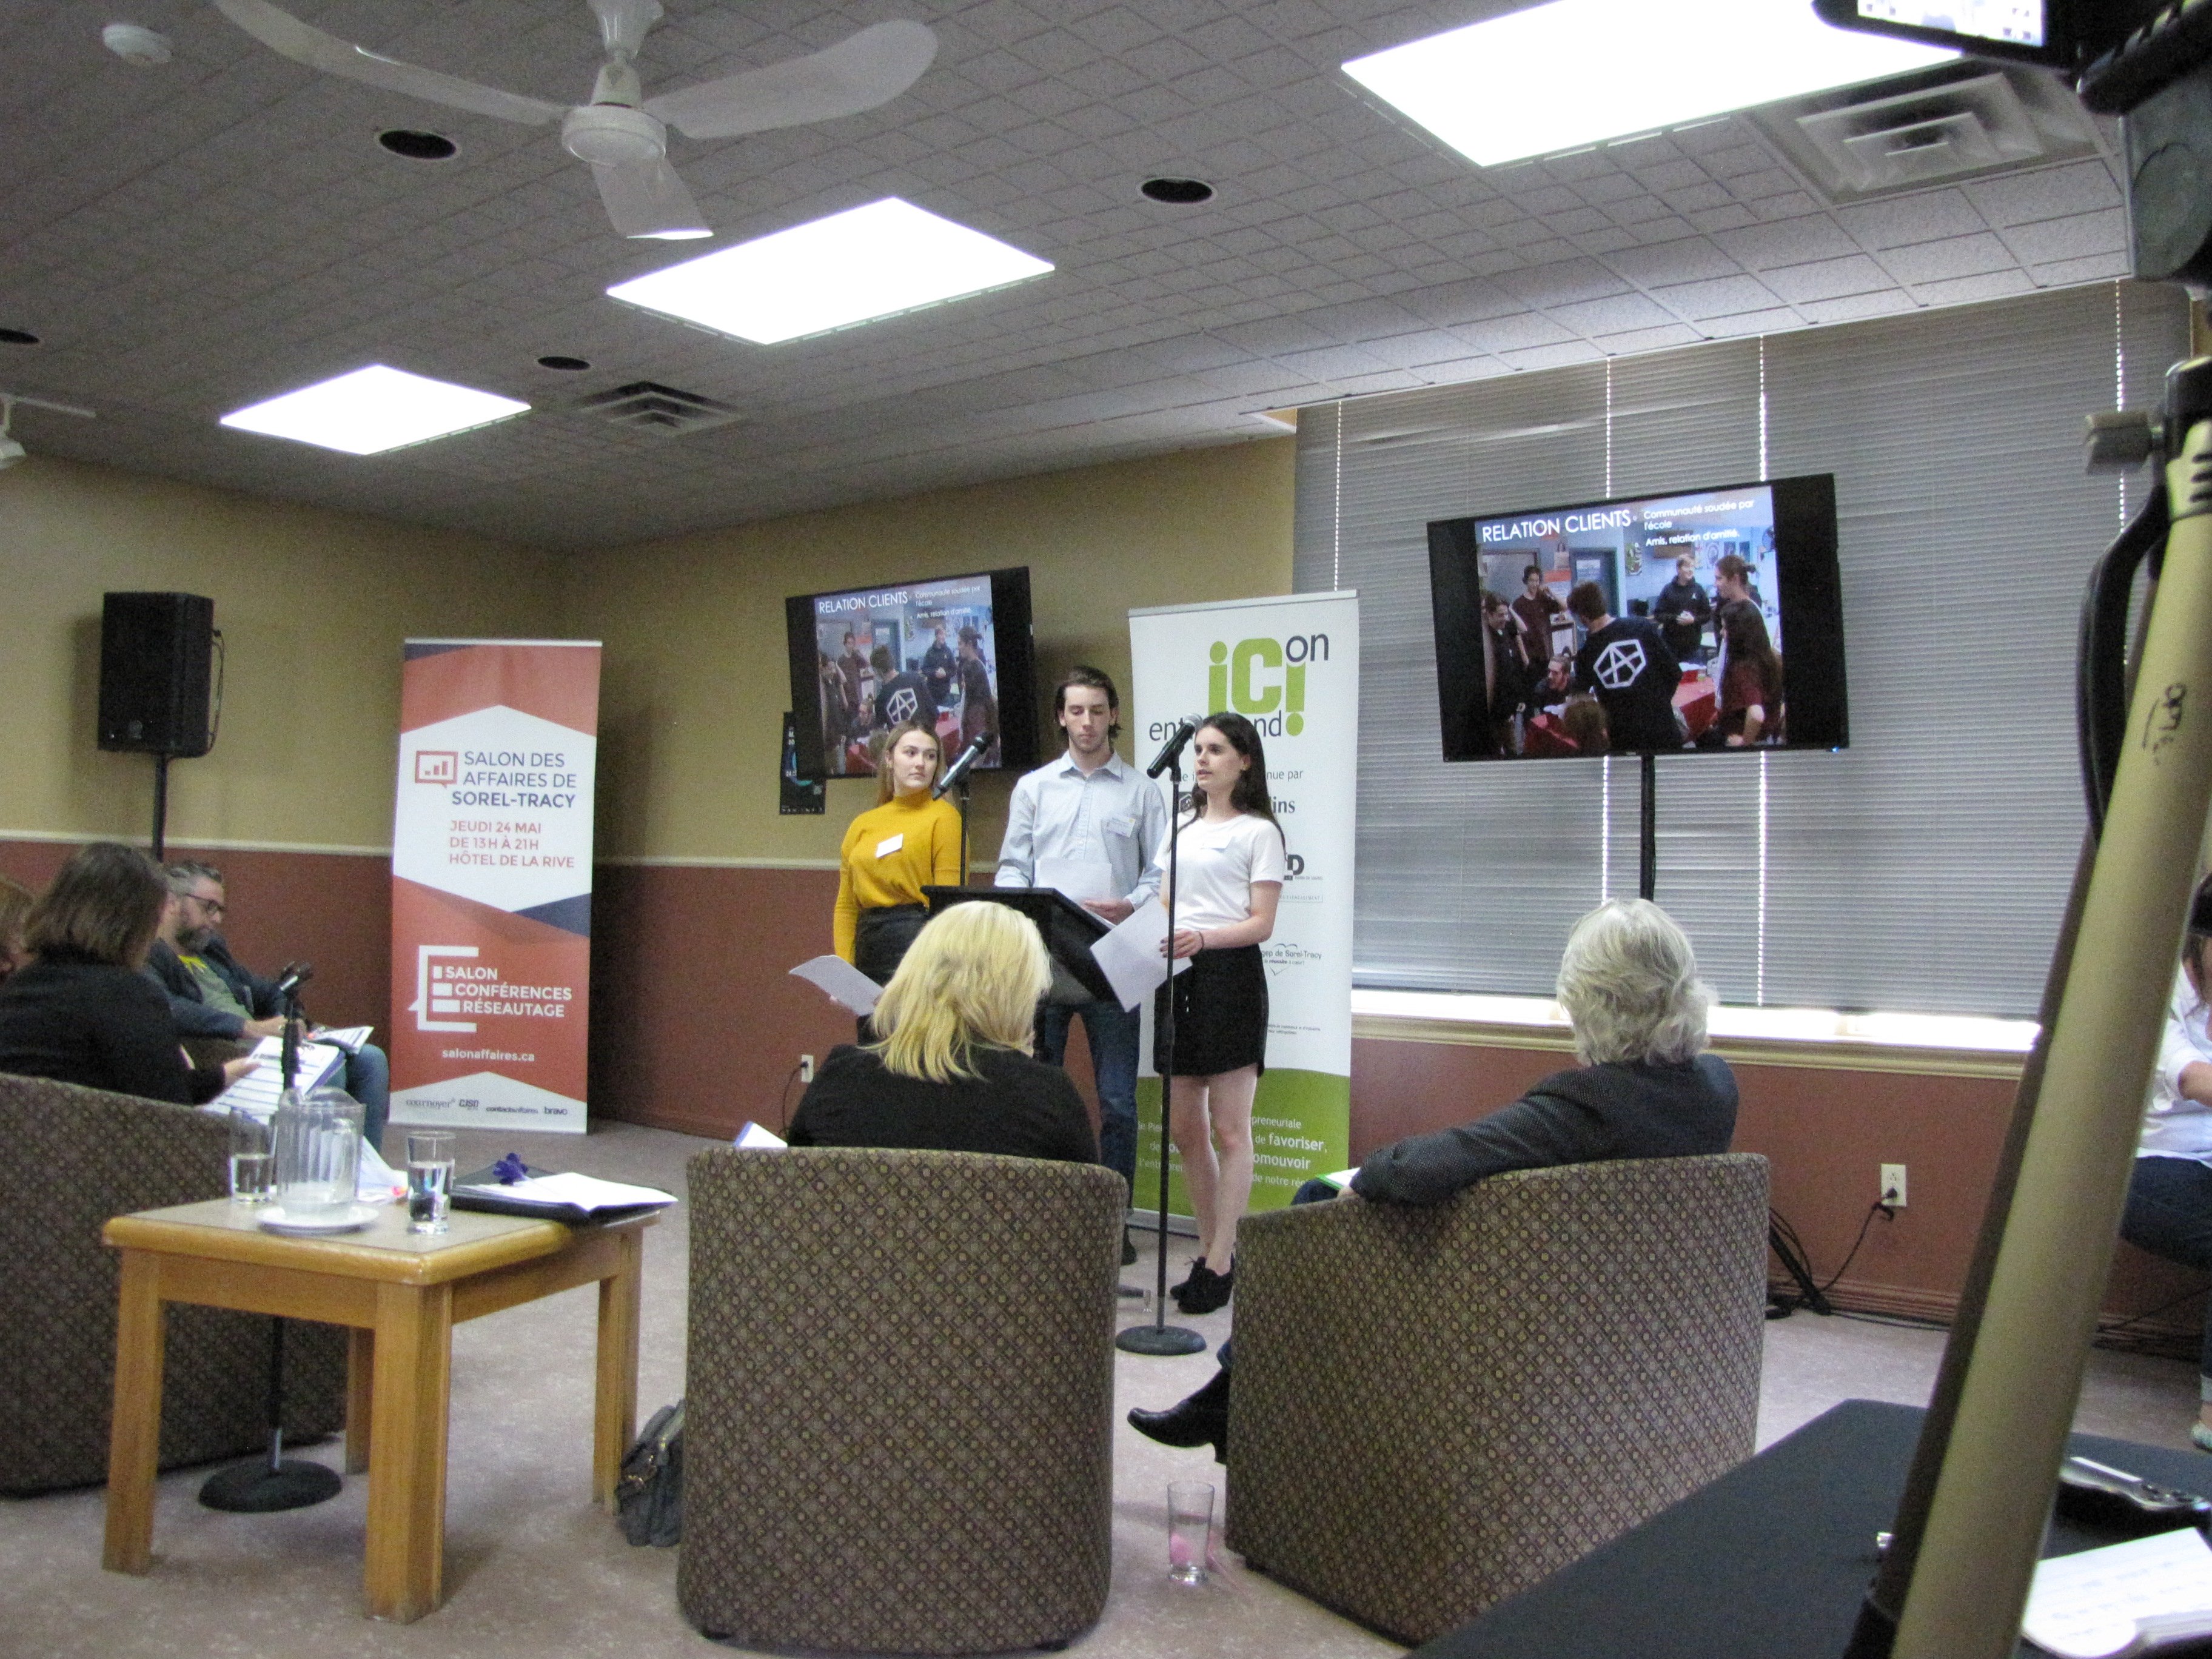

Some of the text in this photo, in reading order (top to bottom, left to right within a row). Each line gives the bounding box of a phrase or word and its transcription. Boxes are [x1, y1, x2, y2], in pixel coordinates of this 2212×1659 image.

[1643, 500, 1755, 520] Communauté soudée par
[1482, 509, 1631, 543] RELATION CLIENTS
[1644, 520, 1672, 531] l'école
[1669, 534, 1701, 545] relation
[819, 591, 908, 614] RELATION CLIENTS
[1285, 633, 1329, 663] on
[464, 751, 565, 768] SALON DES
[463, 771, 577, 788] AFFAIRES DE
[1287, 770, 1304, 782] par
[452, 791, 575, 808] SOREL-TRACY
[450, 820, 541, 834] JEUDI 24 MAI
[449, 836, 469, 848] DE
[501, 835, 511, 850] À
[449, 850, 575, 868] HÔTEL DE LA RIVE
[1261, 950, 1273, 958] gep
[1285, 950, 1322, 960] Sorel-Tracy
[445, 966, 498, 980] SALON
[455, 981, 572, 1001] CONFÉRENCES
[463, 997, 565, 1018] RÉSEAUTAGE
[442, 1047, 535, 1062] salonaffaires.ca
[1252, 1116, 1301, 1129] preneuriale
[1255, 1133, 1266, 1145] de
[1253, 1153, 1311, 1170] omouvoir
[1265, 1176, 1289, 1186] notre
